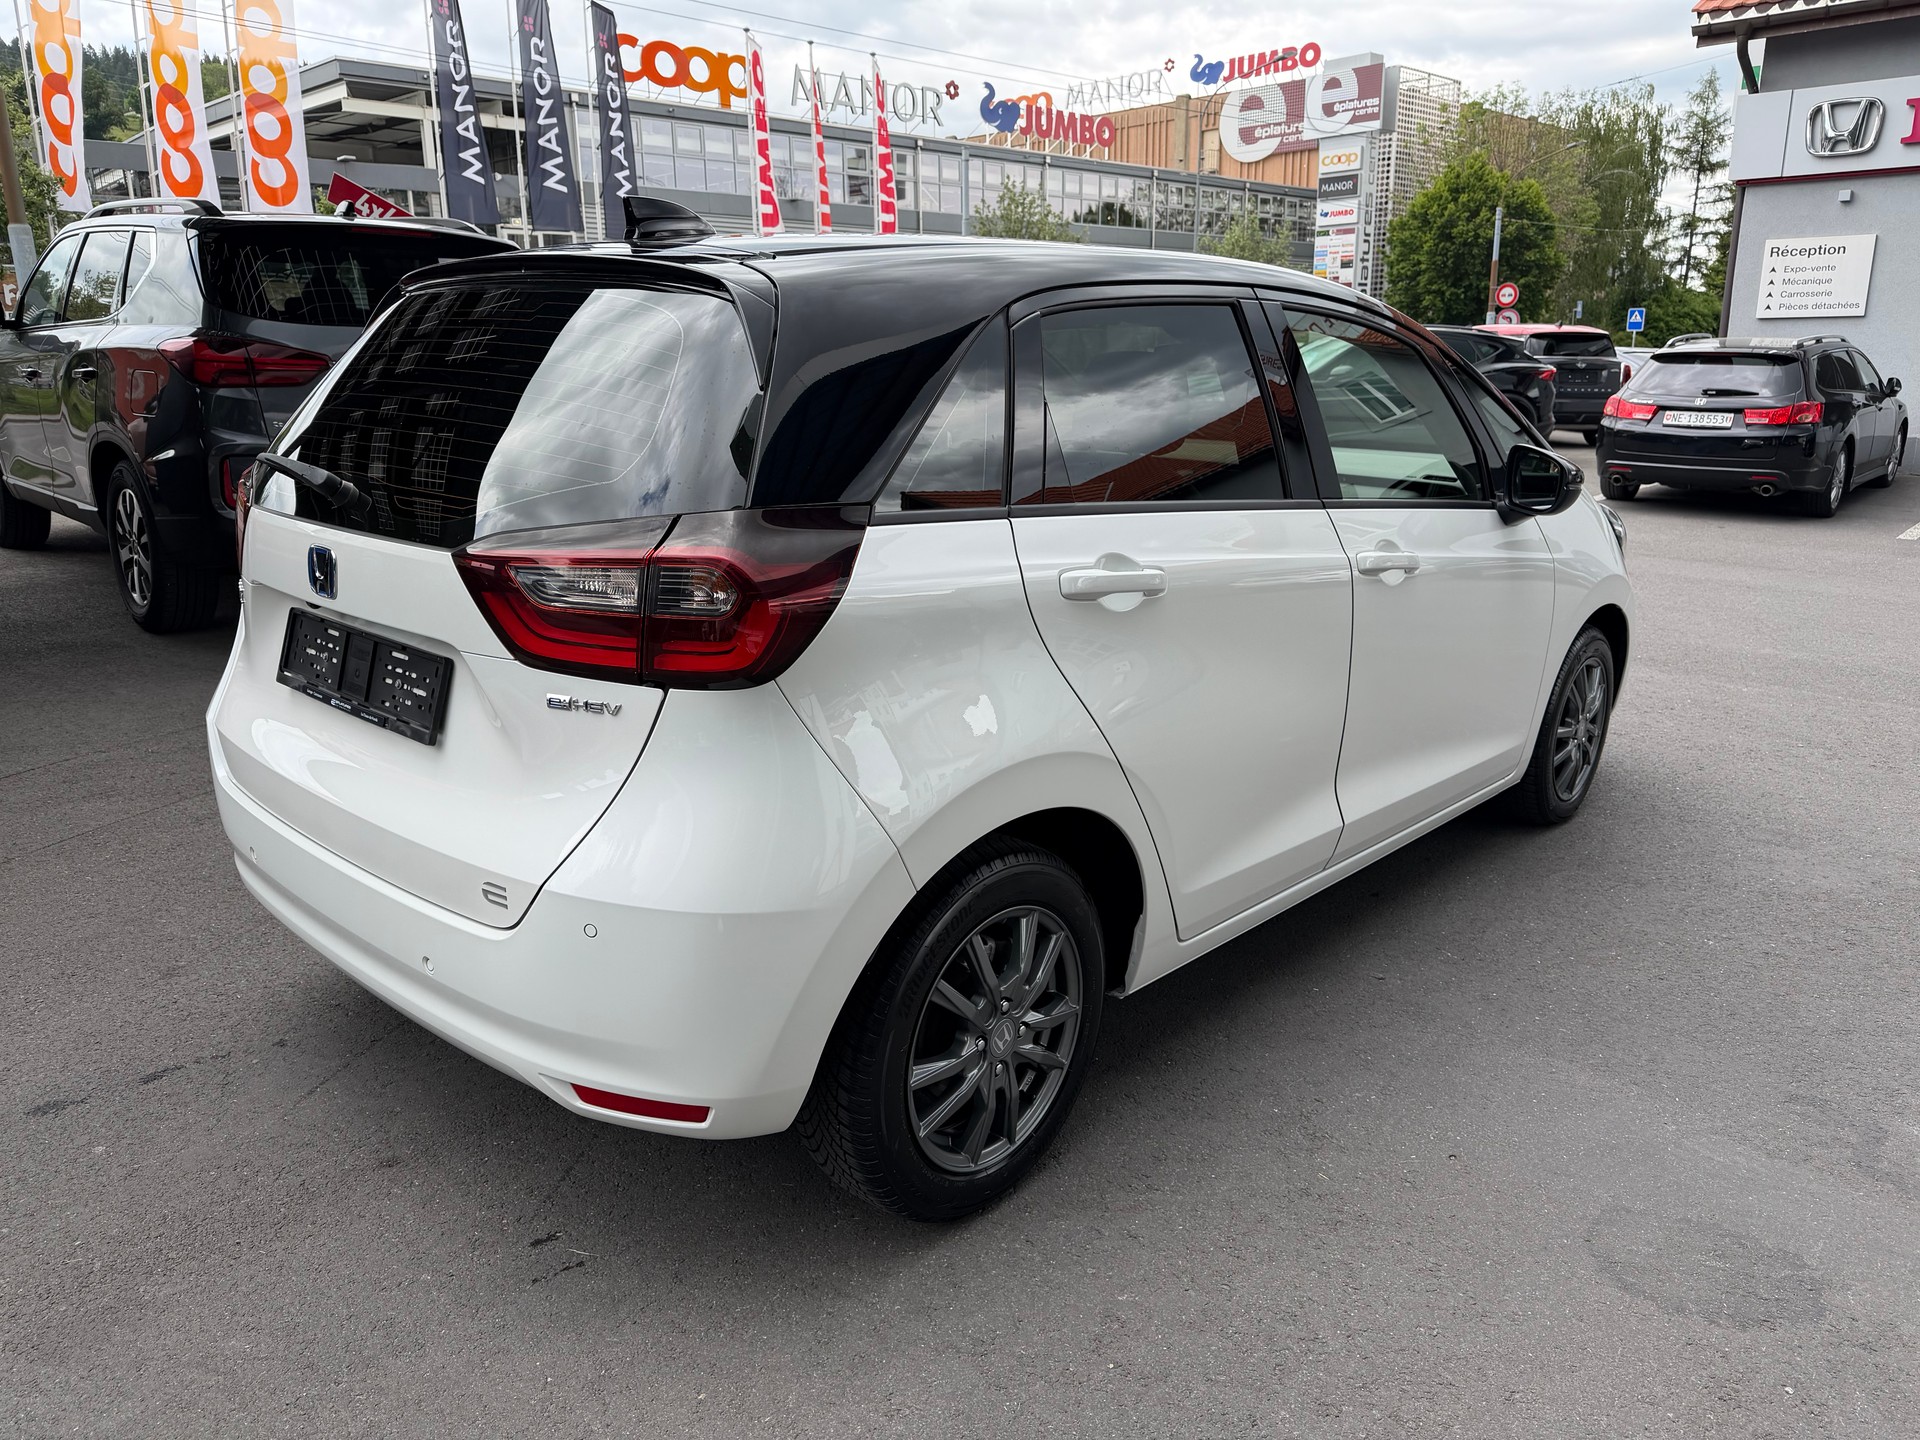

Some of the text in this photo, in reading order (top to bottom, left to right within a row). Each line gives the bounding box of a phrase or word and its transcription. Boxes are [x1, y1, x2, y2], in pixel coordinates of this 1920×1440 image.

[617, 33, 752, 109] coop
[1223, 42, 1321, 83] JUMBO
[148, 0, 204, 198] coop
[446, 20, 486, 185] MANOR
[791, 62, 945, 127] MANOR
[1066, 69, 1163, 109] MANOR
[236, 0, 299, 207] coop
[530, 36, 568, 193] MANOR
[1333, 97, 1380, 112] éplatures
[1355, 106, 1379, 116] centre
[604, 52, 633, 198] MANOR
[1019, 104, 1116, 148] JUMBO
[1254, 123, 1304, 138] éplature
[751, 49, 780, 236] UMBO
[1321, 152, 1358, 167] coop
[1321, 180, 1354, 192] MANOR
[1329, 208, 1354, 218] JUMBO
[1769, 243, 1847, 259] Réception
[1781, 276, 1833, 288] Mécanique
[1783, 263, 1837, 275] Expo-vente
[1778, 300, 1860, 311] Pièces détachées
[1780, 289, 1833, 299] Carrosserie
